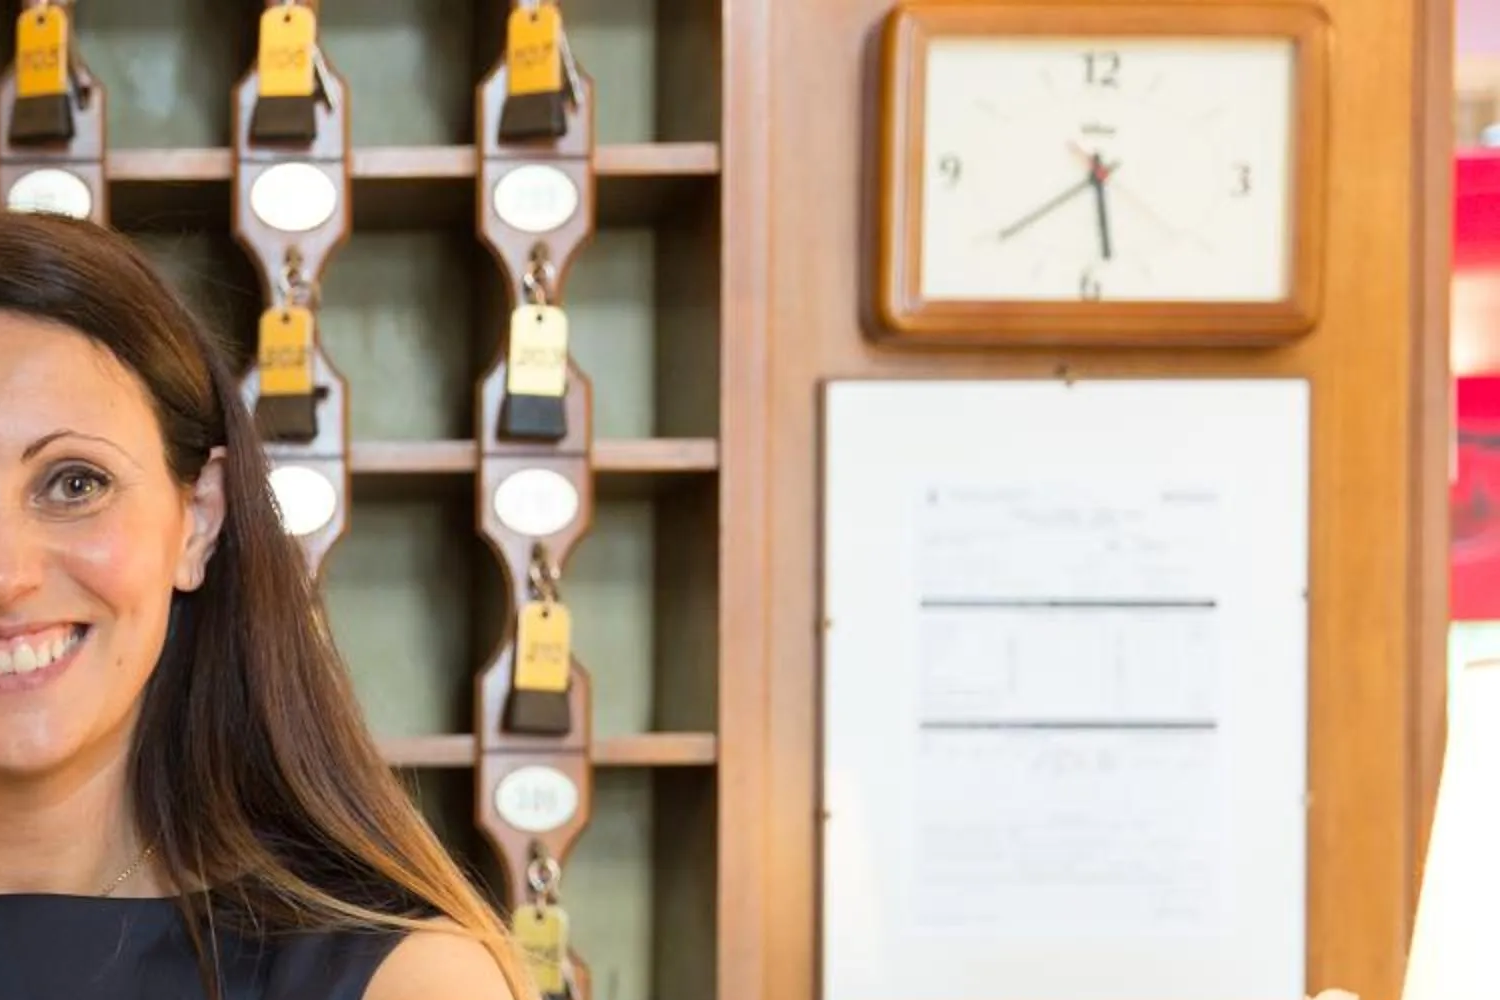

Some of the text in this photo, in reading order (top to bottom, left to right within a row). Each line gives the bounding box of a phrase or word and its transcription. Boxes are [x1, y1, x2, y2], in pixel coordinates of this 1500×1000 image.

[1081, 50, 1121, 88] 12
[938, 153, 962, 190] 9
[1231, 164, 1252, 197] 3
[1080, 266, 1103, 300] 6
